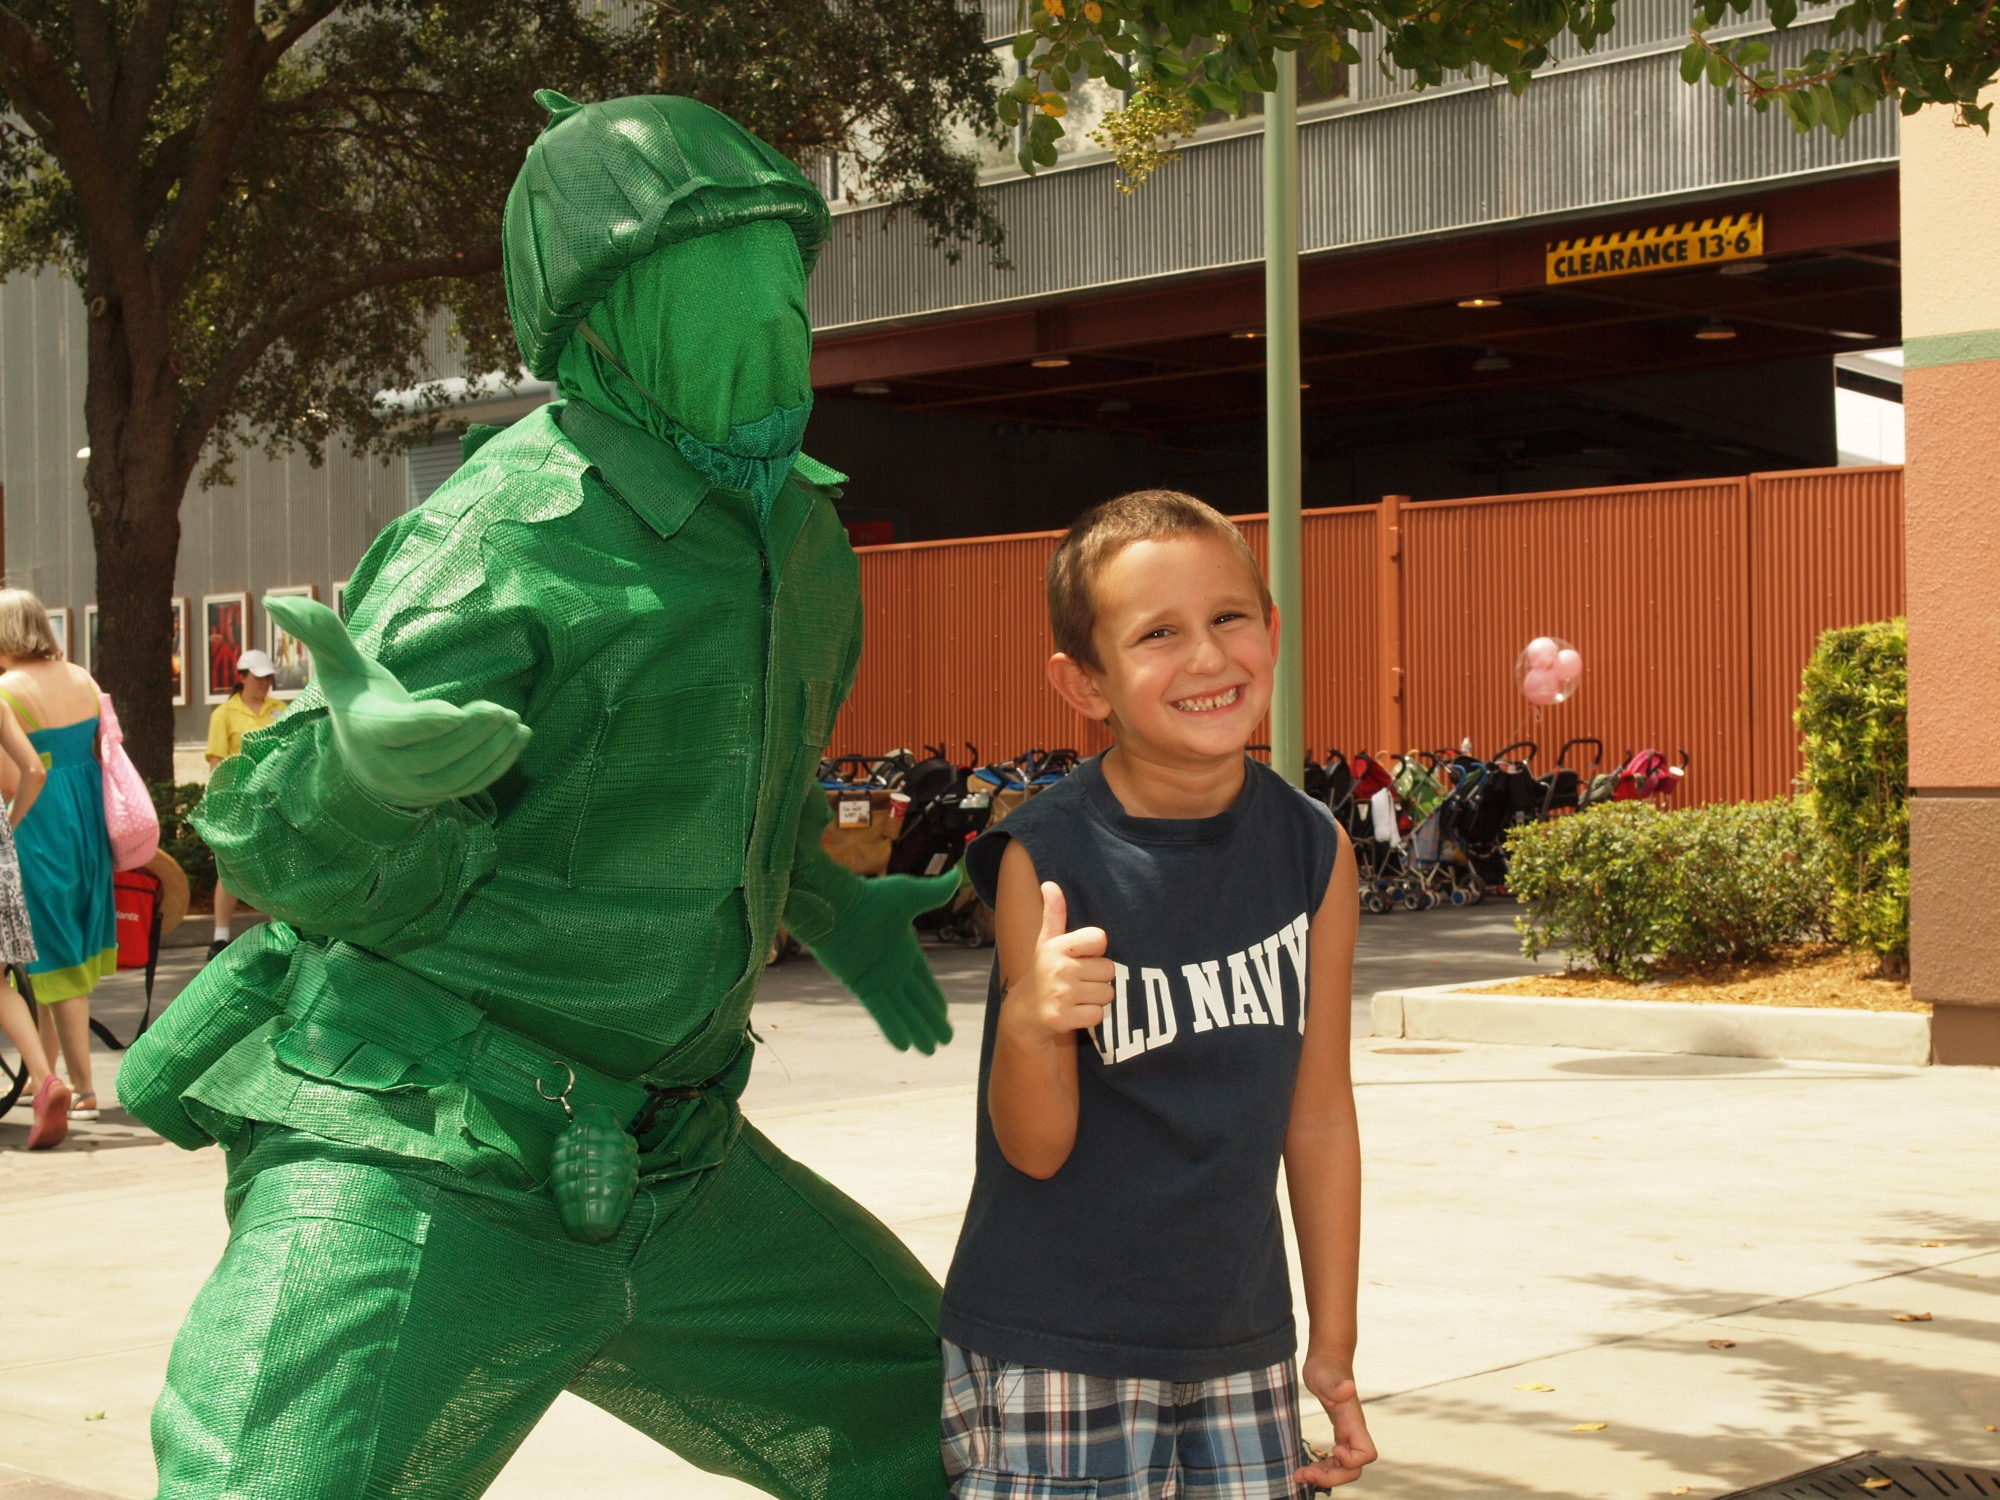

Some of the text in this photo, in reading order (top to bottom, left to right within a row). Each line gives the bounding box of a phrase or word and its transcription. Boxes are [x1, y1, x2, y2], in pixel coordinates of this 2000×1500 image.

[1554, 240, 1688, 278] CLEARANCE
[116, 911, 140, 922] lantic
[1181, 911, 1309, 1036] NAVY
